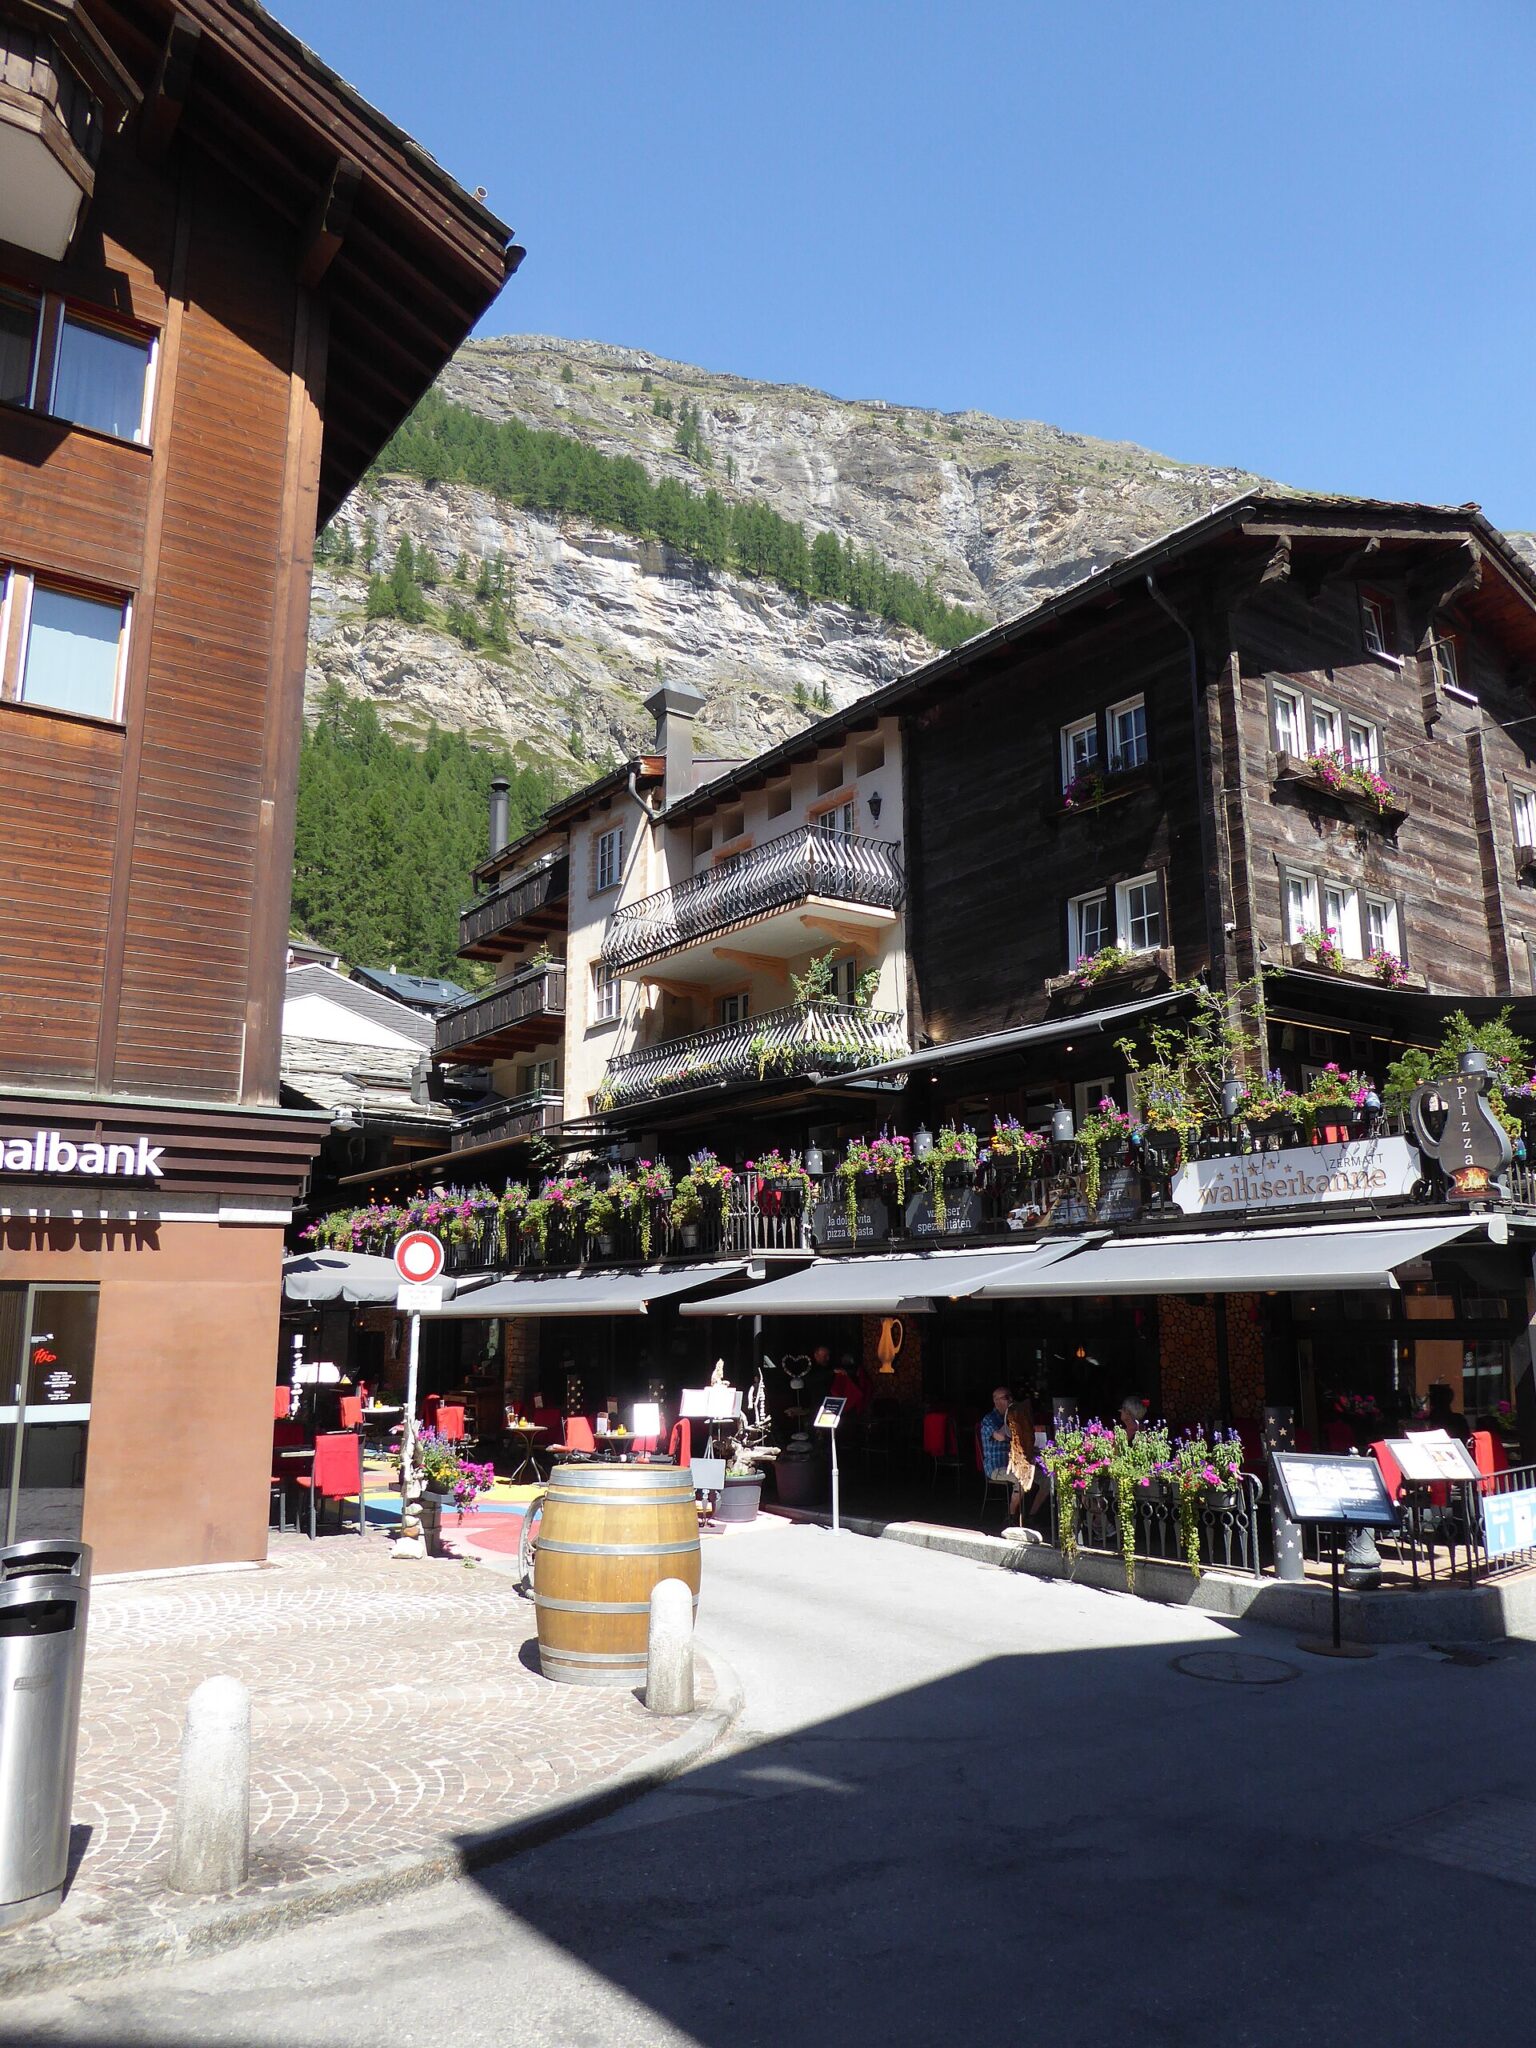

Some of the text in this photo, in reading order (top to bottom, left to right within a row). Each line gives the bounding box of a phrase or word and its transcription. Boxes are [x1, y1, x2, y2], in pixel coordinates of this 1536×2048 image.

[1456, 1086, 1474, 1165] Pizza
[1329, 1153, 1384, 1169] ZERMATT
[1198, 1168, 1387, 1205] walliserkanne
[926, 1206, 961, 1218] wiser
[836, 1214, 855, 1226] dol
[826, 1229, 846, 1241] pizza
